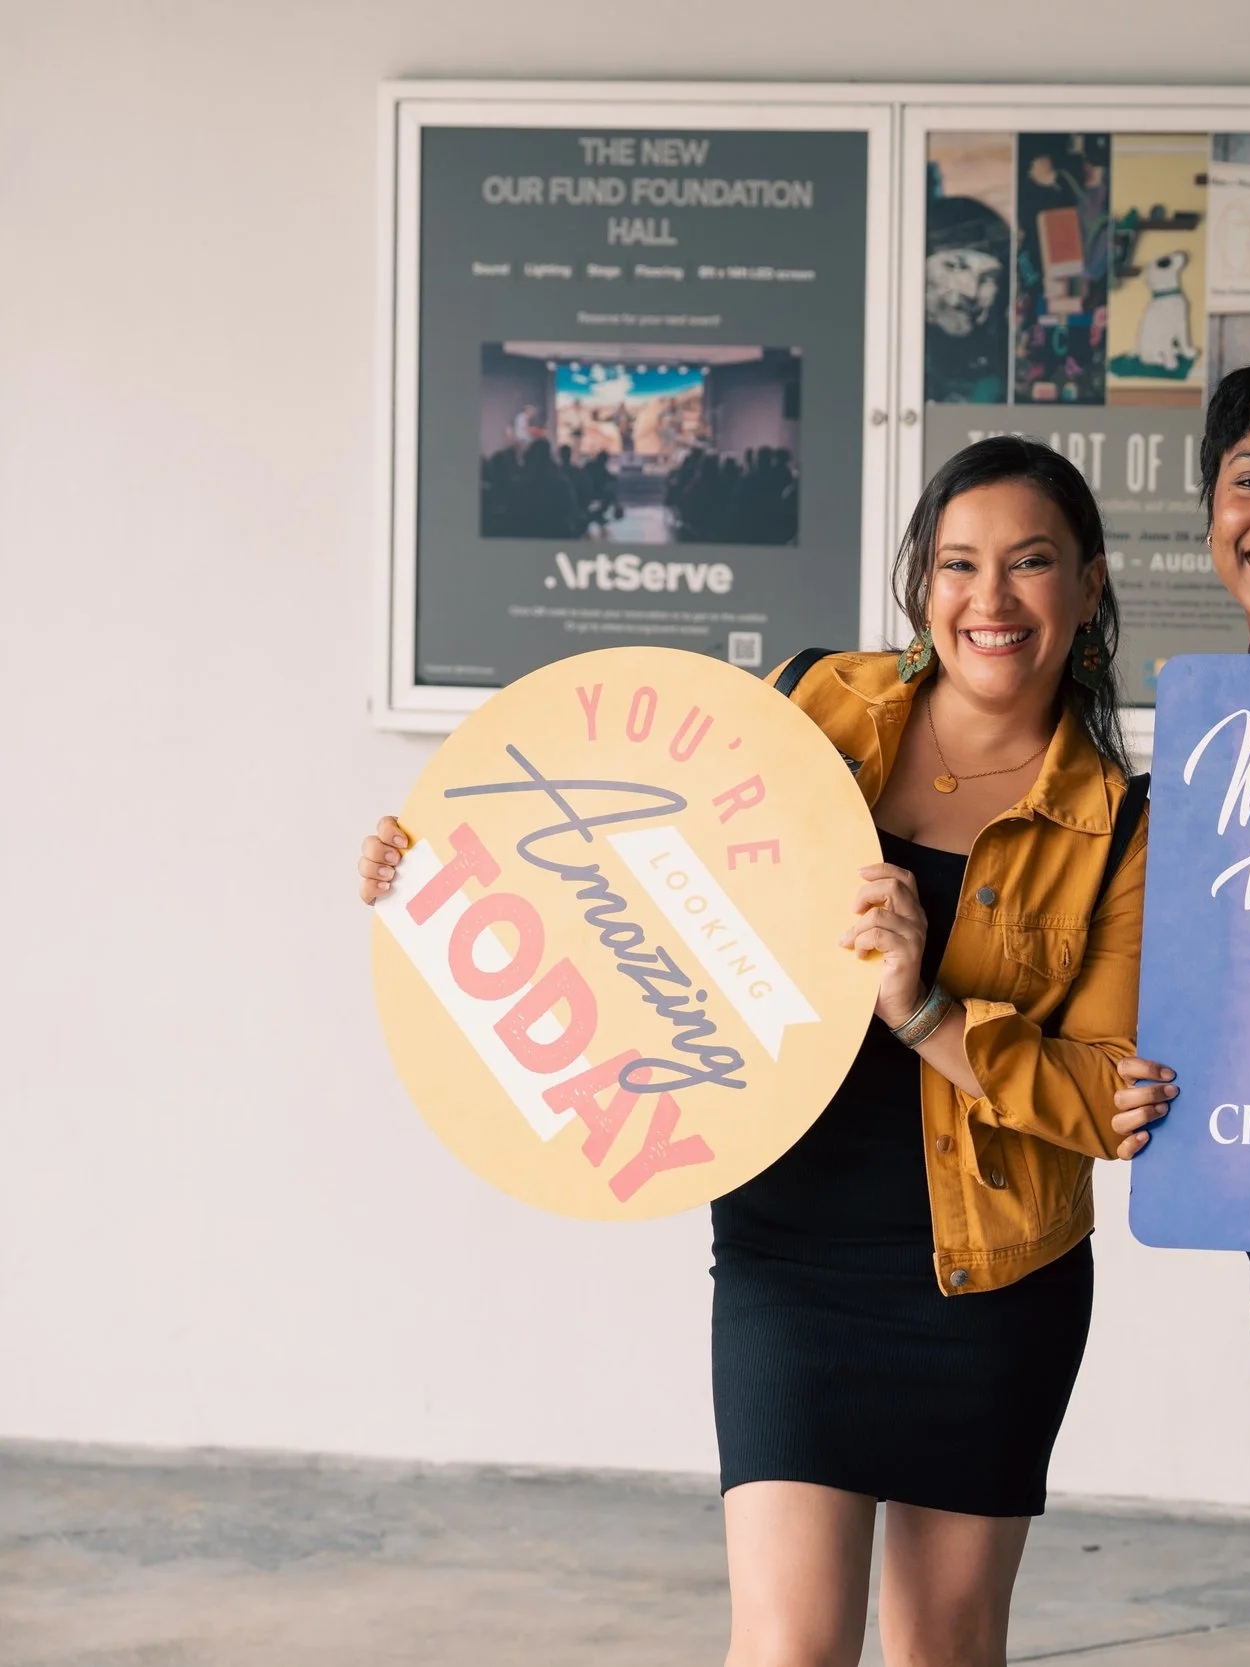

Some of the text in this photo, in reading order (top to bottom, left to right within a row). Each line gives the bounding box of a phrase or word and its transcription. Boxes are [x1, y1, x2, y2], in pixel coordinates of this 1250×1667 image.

[579, 137, 710, 167] THE NEW
[482, 177, 814, 208] OUR FUND FOUNDATION
[607, 217, 678, 245] HALL
[1126, 433, 1164, 493] OF
[1149, 552, 1217, 574] AUGU
[575, 683, 781, 870] YOU'RE
[444, 743, 747, 1093] Amazing
[648, 852, 772, 1000] LOOKING
[405, 821, 715, 1204] TODAY
